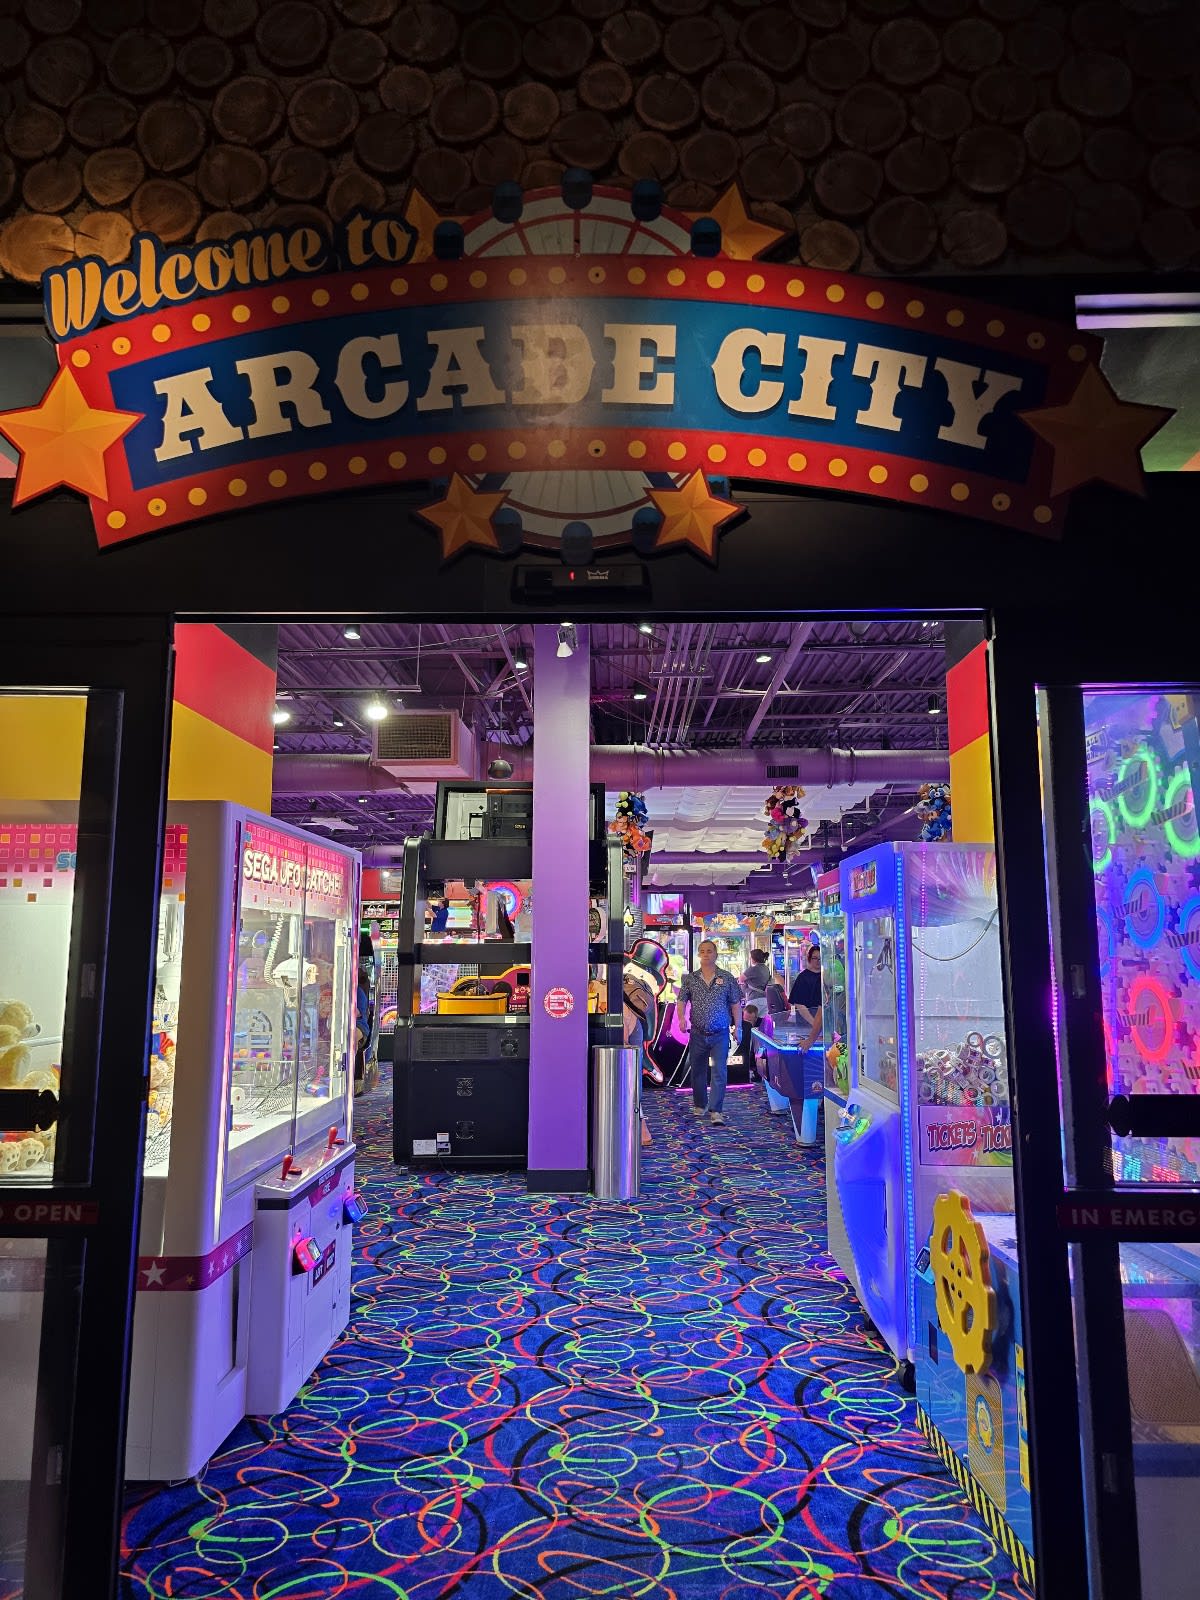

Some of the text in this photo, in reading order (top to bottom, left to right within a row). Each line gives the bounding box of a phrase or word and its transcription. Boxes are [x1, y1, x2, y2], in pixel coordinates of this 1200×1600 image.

[48, 213, 411, 338] Welcome to
[153, 323, 1023, 463] ARCADE CITY
[243, 848, 279, 885] SEGA
[280, 857, 302, 890] UFO
[927, 1120, 977, 1152] TICKETS
[14, 1203, 82, 1222] OPEN
[1070, 1208, 1199, 1227] IN EMERG
